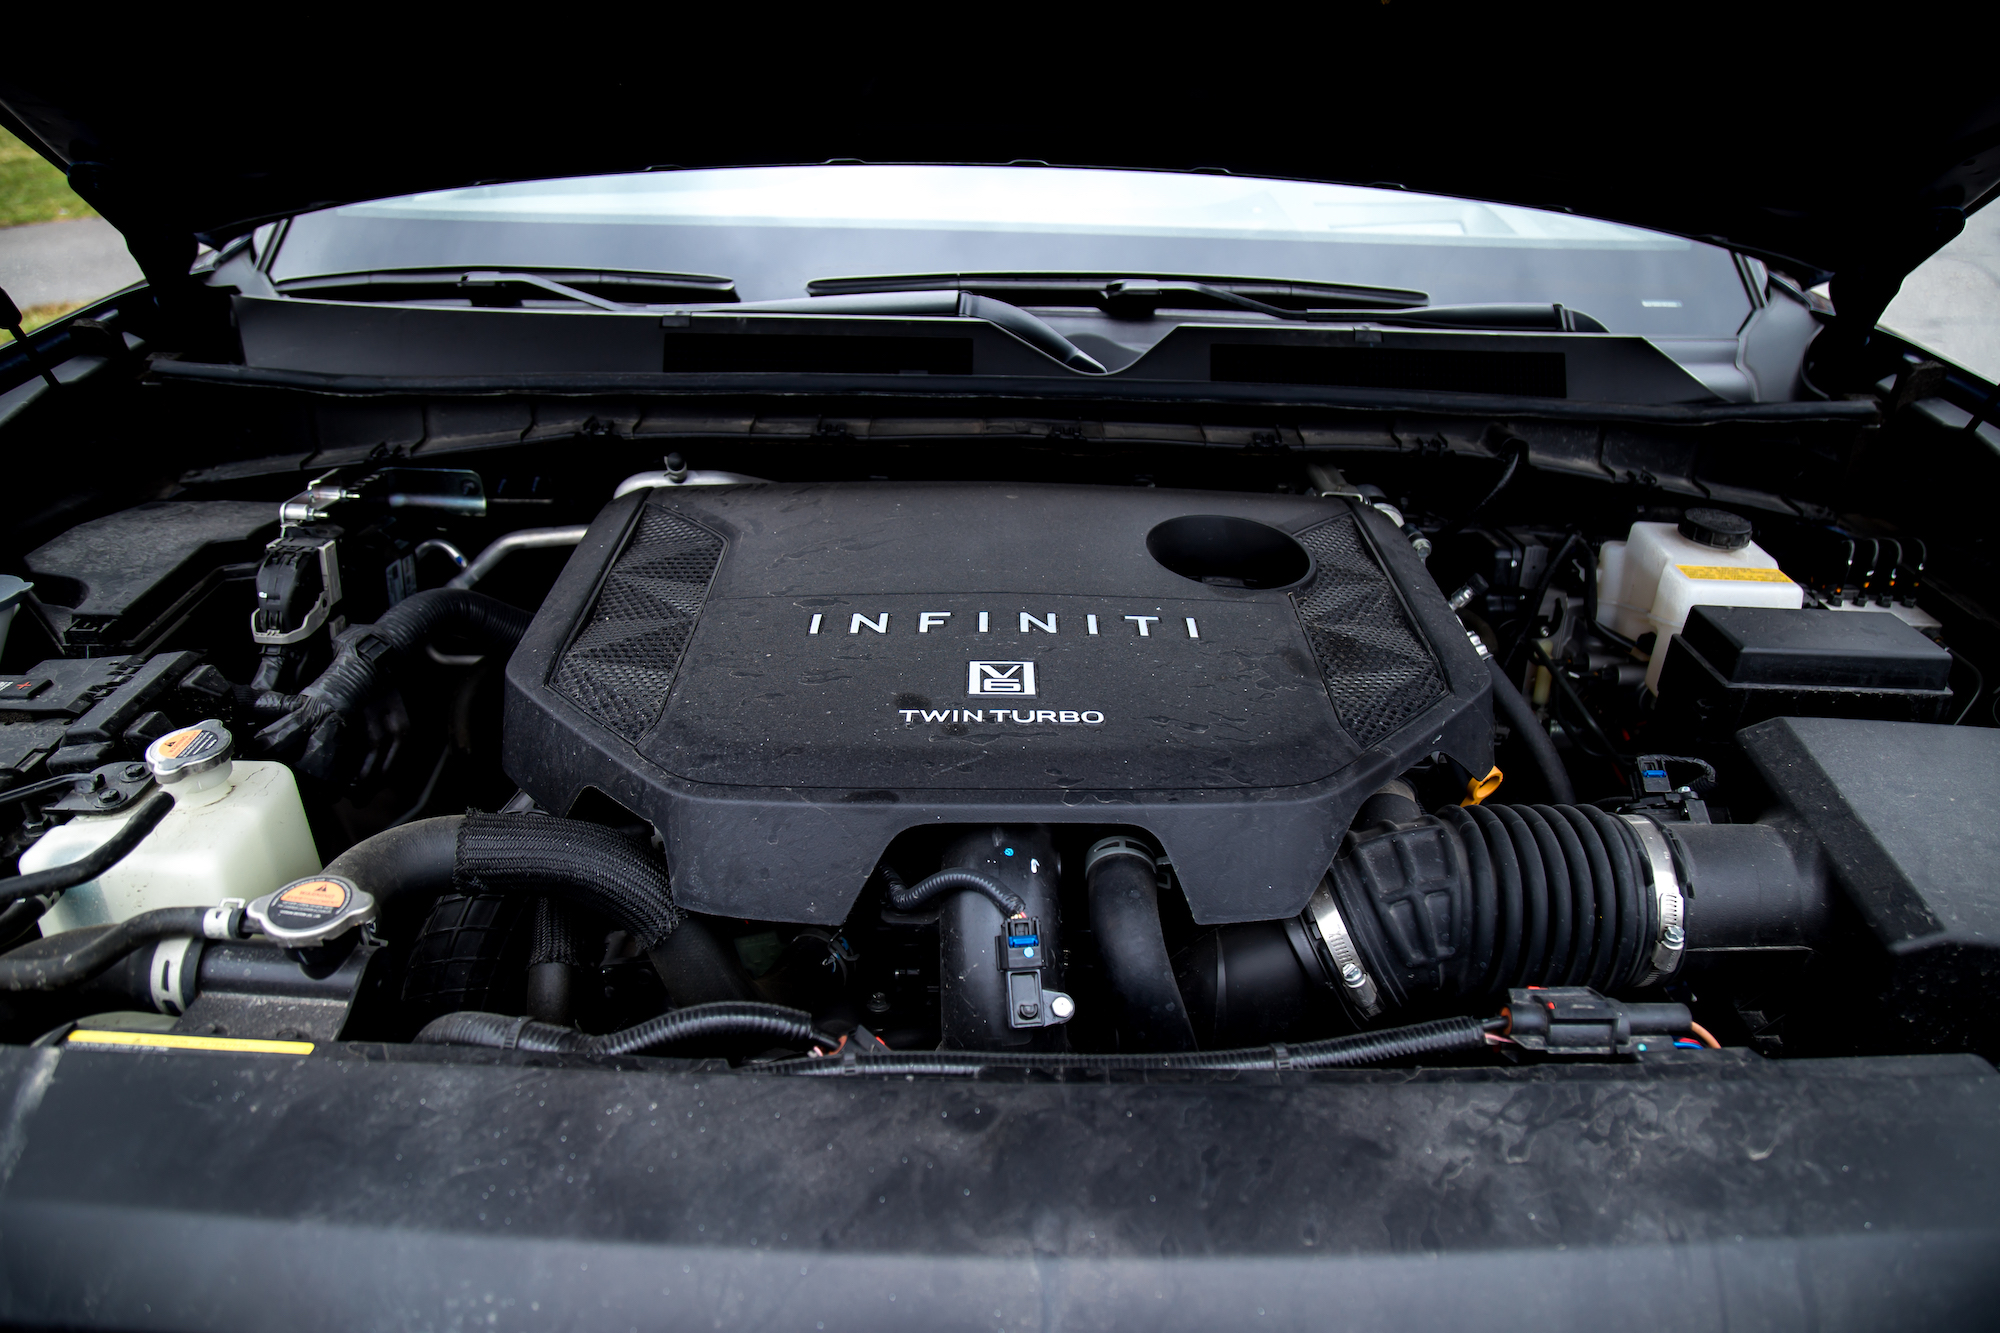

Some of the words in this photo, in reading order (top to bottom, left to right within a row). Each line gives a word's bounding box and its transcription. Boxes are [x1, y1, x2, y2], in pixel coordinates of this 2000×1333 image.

[809, 611, 1199, 639] INFINITI
[898, 709, 983, 723] TWIN
[988, 709, 1105, 724] TURBO
